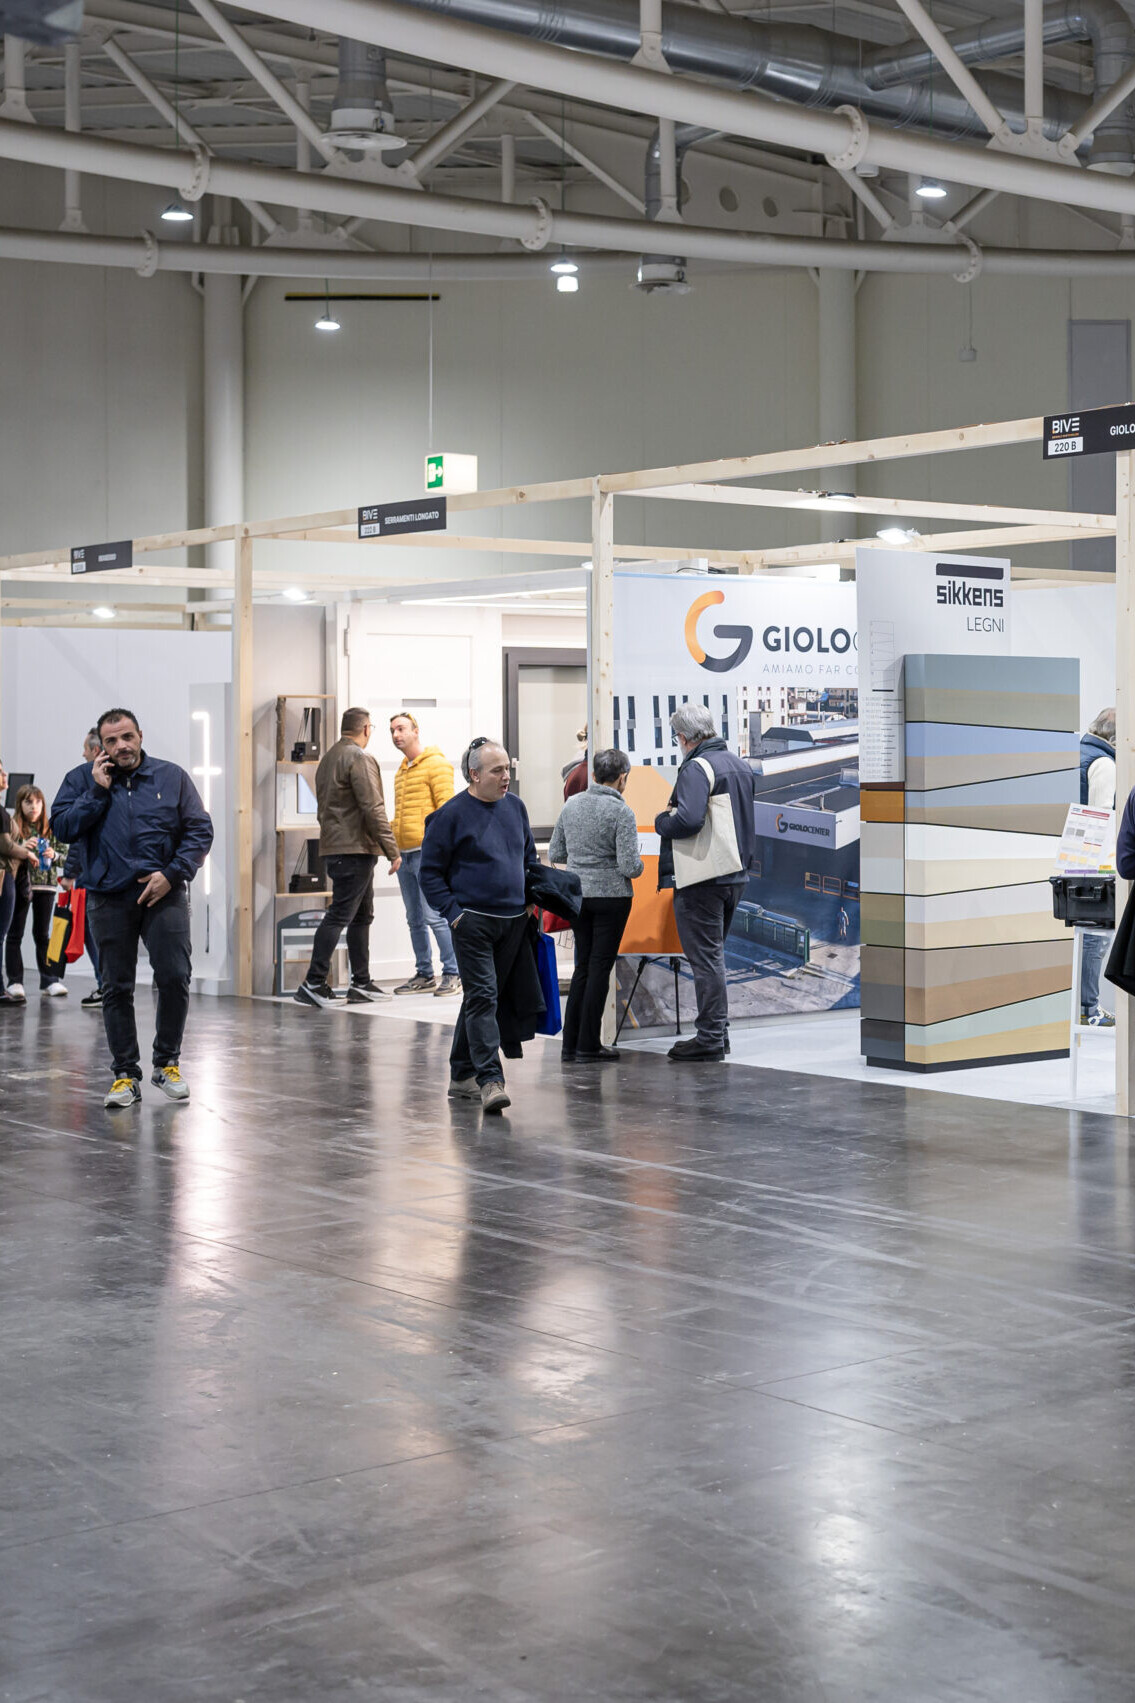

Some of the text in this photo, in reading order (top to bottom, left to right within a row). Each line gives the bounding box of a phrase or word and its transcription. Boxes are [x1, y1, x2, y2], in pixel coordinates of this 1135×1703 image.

[1052, 417, 1080, 434] BIVE
[1054, 440, 1077, 453] 220 B
[936, 580, 1004, 608] sikkens
[967, 616, 1005, 633] LEGNI
[763, 625, 858, 654] GIOLO
[763, 664, 814, 675] AMIAMO
[819, 665, 840, 675] FAR
[789, 823, 830, 837] GIOLOCENTER
